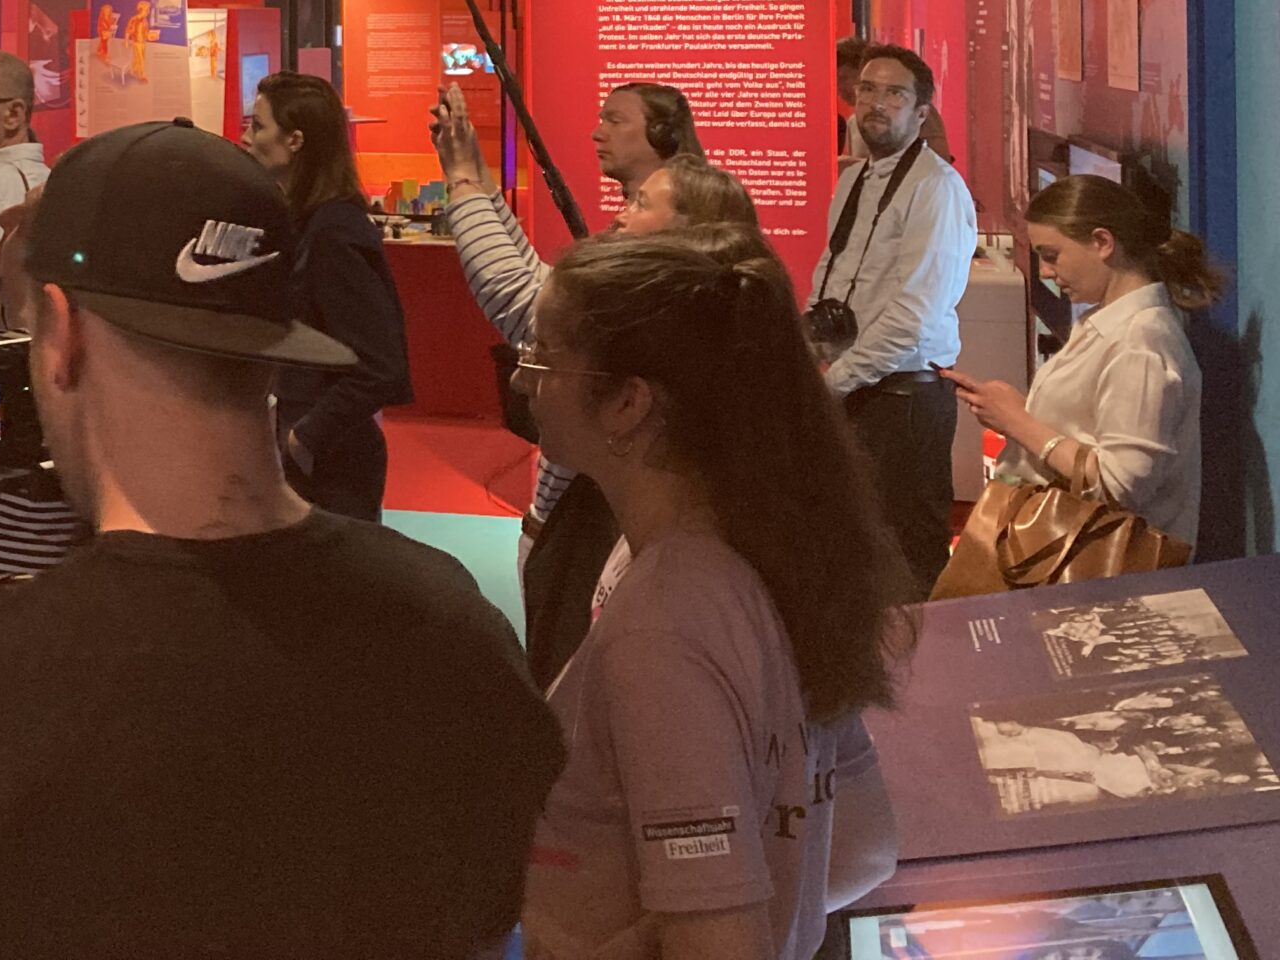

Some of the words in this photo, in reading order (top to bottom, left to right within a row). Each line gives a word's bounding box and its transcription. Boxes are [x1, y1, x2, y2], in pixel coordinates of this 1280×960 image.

[634, 4, 649, 12] und
[779, 3, 805, 12] gingen
[775, 12, 805, 20] Freiheit
[793, 22, 805, 30] für
[641, 42, 681, 50] Frankfurter
[683, 42, 726, 50] Paulskirche
[607, 61, 615, 69] Es
[751, 62, 778, 70] heutige
[779, 61, 806, 69] Grund-
[668, 839, 727, 857] Freiheit
